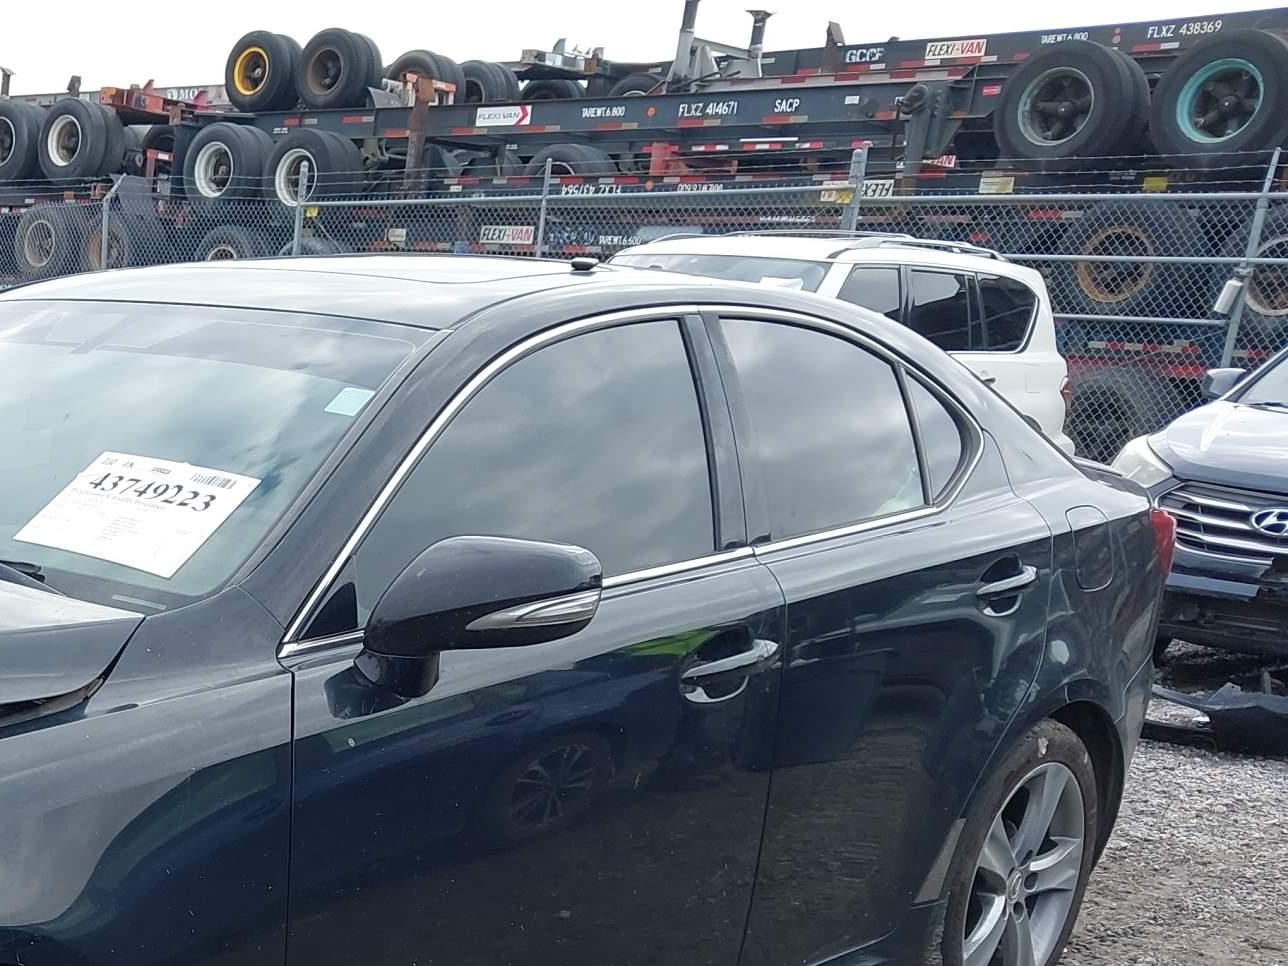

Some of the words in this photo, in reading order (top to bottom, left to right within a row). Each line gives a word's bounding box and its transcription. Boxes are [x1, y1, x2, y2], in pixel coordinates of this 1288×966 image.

[1147, 24, 1176, 39] FLXZ
[1179, 19, 1223, 36] 438369
[926, 41, 985, 57] FLEXI-VAN
[678, 102, 704, 118] FLXZ
[706, 100, 738, 116] 414671
[774, 98, 800, 113] SACP
[88, 472, 217, 512] 43749223
